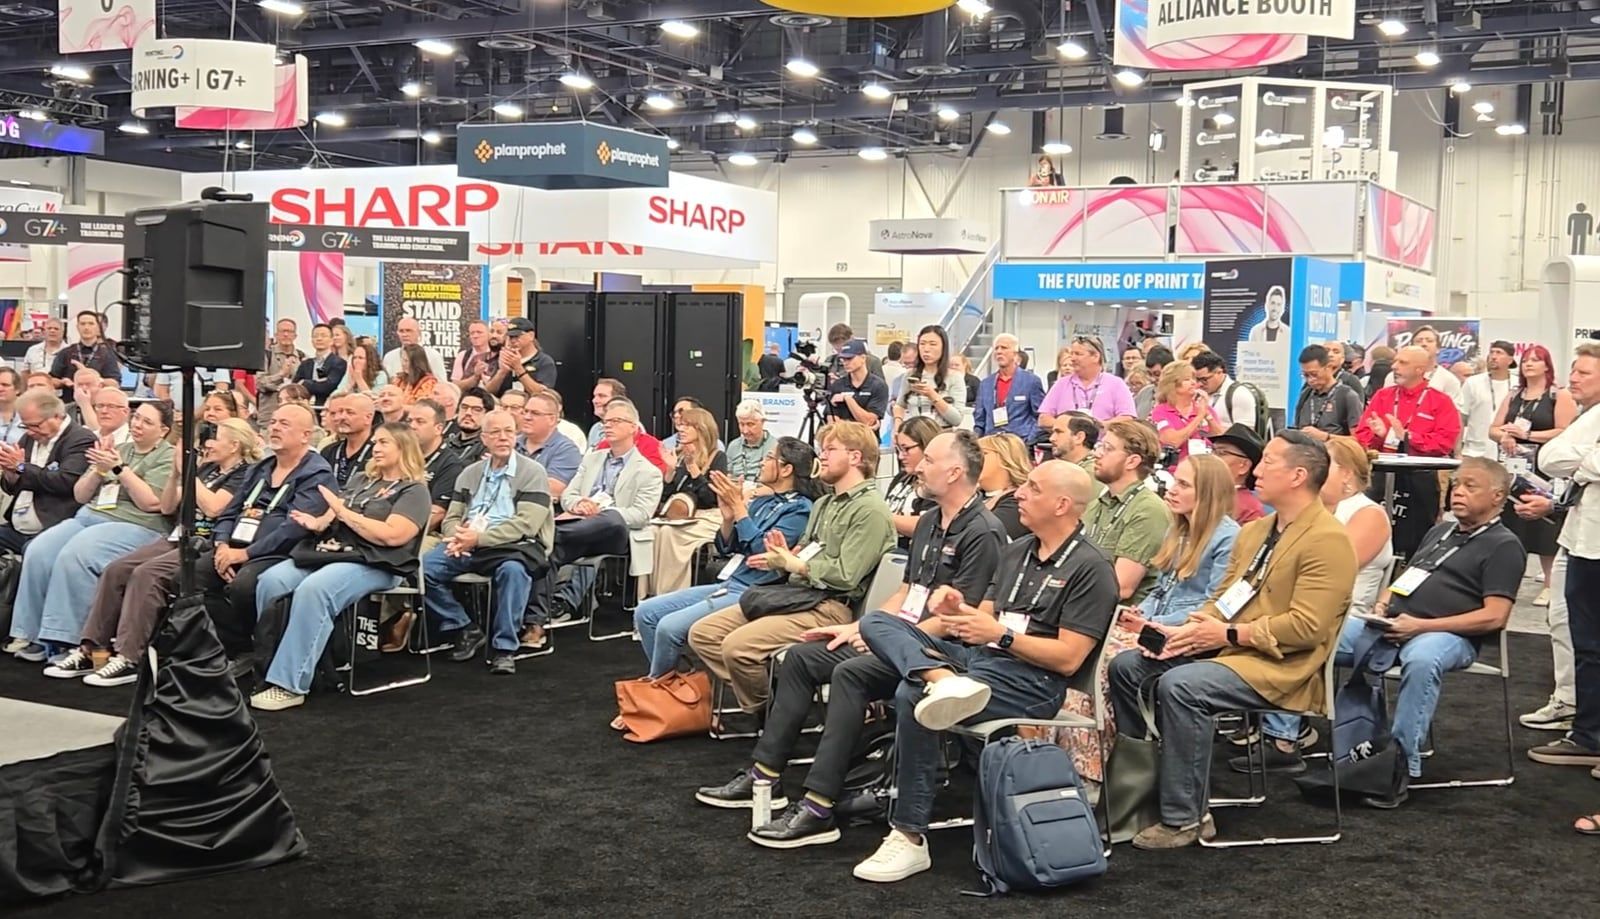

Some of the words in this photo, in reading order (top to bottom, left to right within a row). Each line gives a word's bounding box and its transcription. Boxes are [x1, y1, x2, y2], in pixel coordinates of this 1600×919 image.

[1158, 0, 1249, 26] ALLIANCE
[1256, 0, 1332, 16] BOOTH
[206, 69, 246, 90] G7+
[494, 143, 566, 160] planprophet
[611, 148, 660, 168] planprophet
[270, 183, 499, 226] SHARP
[1032, 191, 1048, 204] ON
[1049, 190, 1070, 204] AIR
[649, 195, 745, 234] SHARP
[892, 230, 933, 240] AstroNova
[1038, 273, 1064, 289] THE
[1066, 273, 1120, 289] FUTURE
[1123, 273, 1142, 289] OF
[1145, 273, 1189, 289] PRINT
[1310, 284, 1323, 307] TELL
[402, 301, 461, 320] STAND
[434, 332, 461, 346] THE
[762, 398, 796, 407] BRANDS
[357, 616, 378, 633] THE
